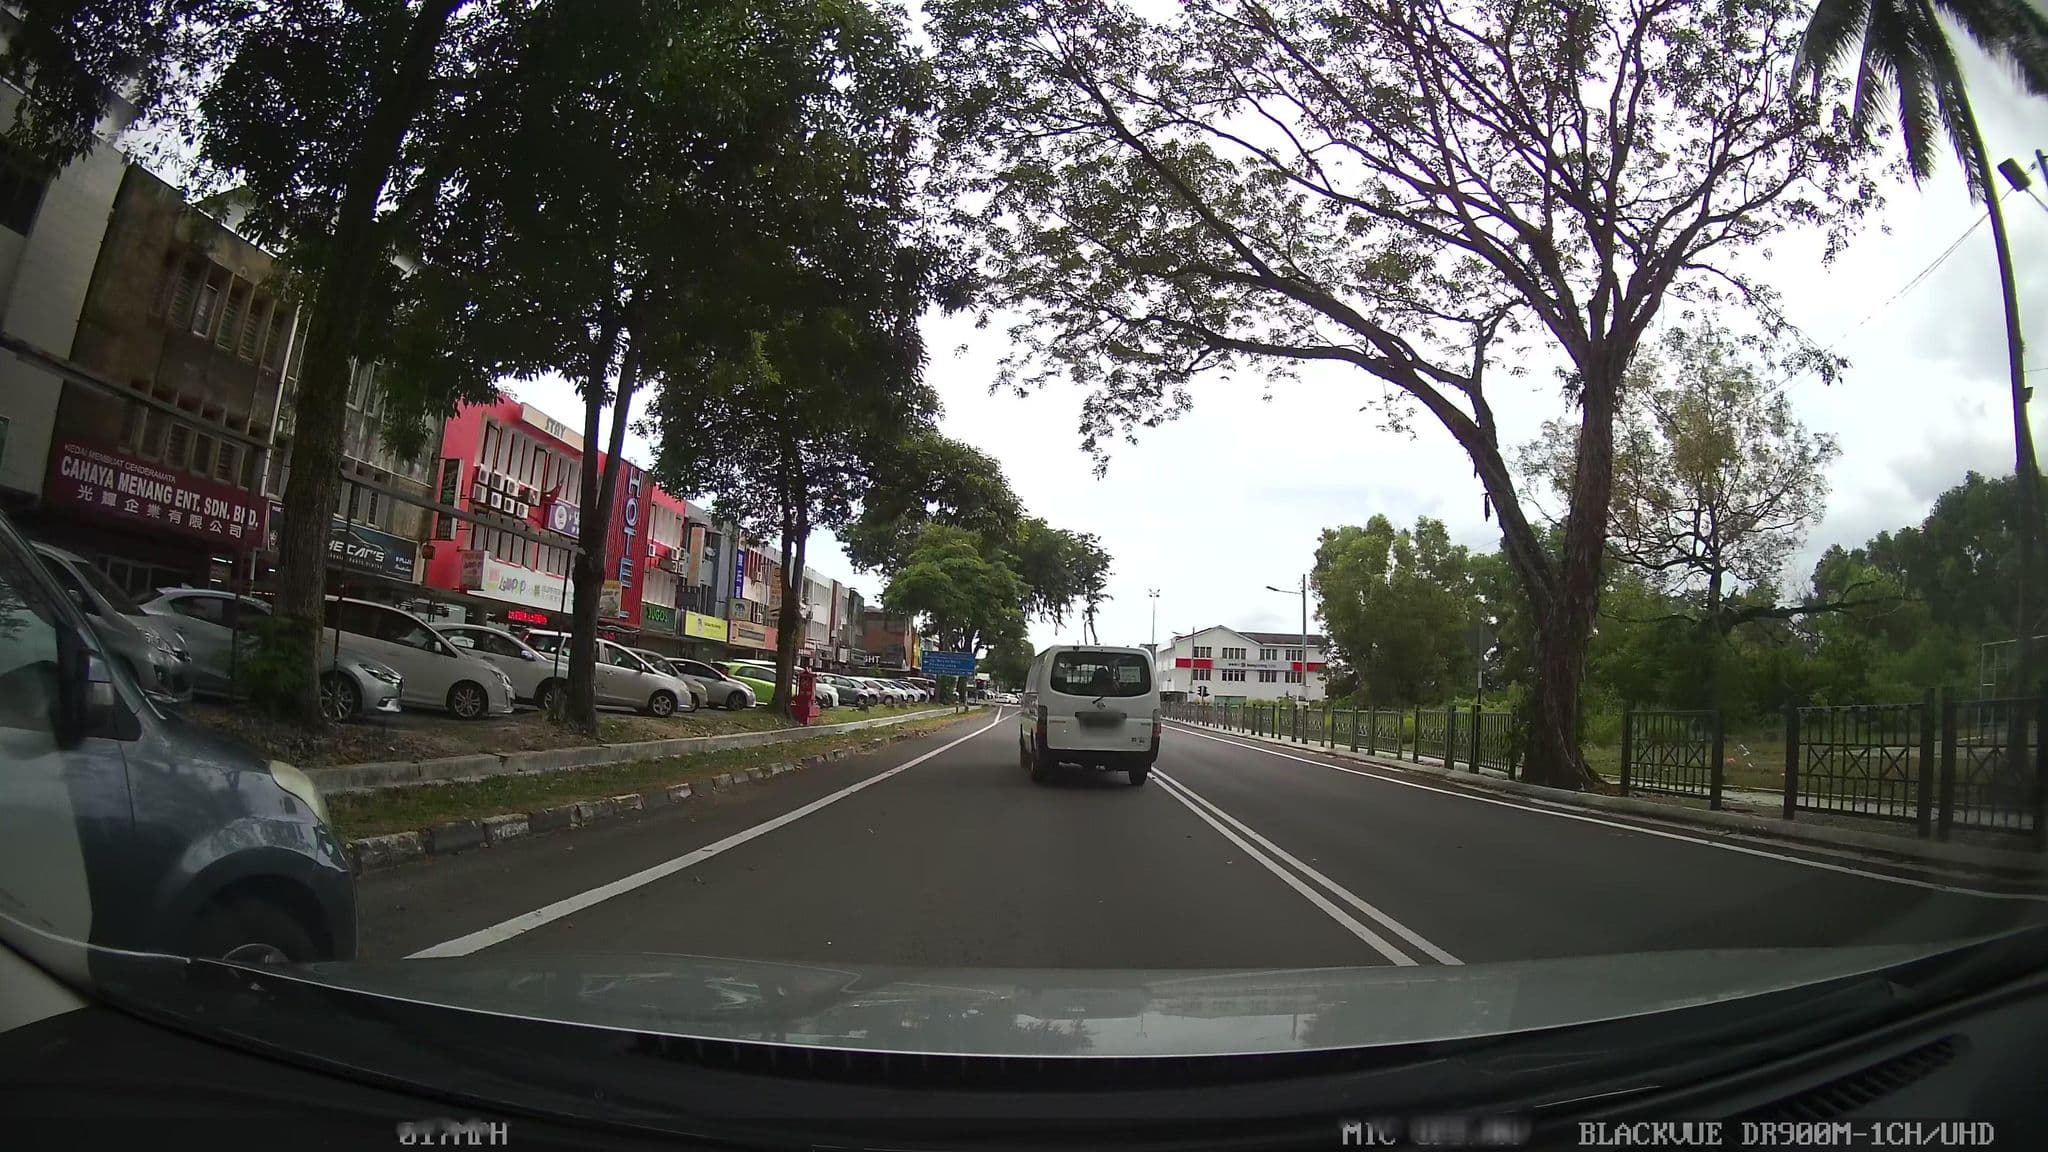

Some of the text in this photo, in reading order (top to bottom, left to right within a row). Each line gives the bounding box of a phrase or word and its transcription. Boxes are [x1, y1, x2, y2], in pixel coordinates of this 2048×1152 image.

[545, 417, 567, 439] STAY
[64, 444, 176, 484] KEDAI MEMBUAT CENDERAMATA
[61, 455, 114, 489] CAHAYA
[118, 472, 172, 504] MENANG
[175, 489, 200, 511] ENT.
[204, 497, 230, 521] SDN.
